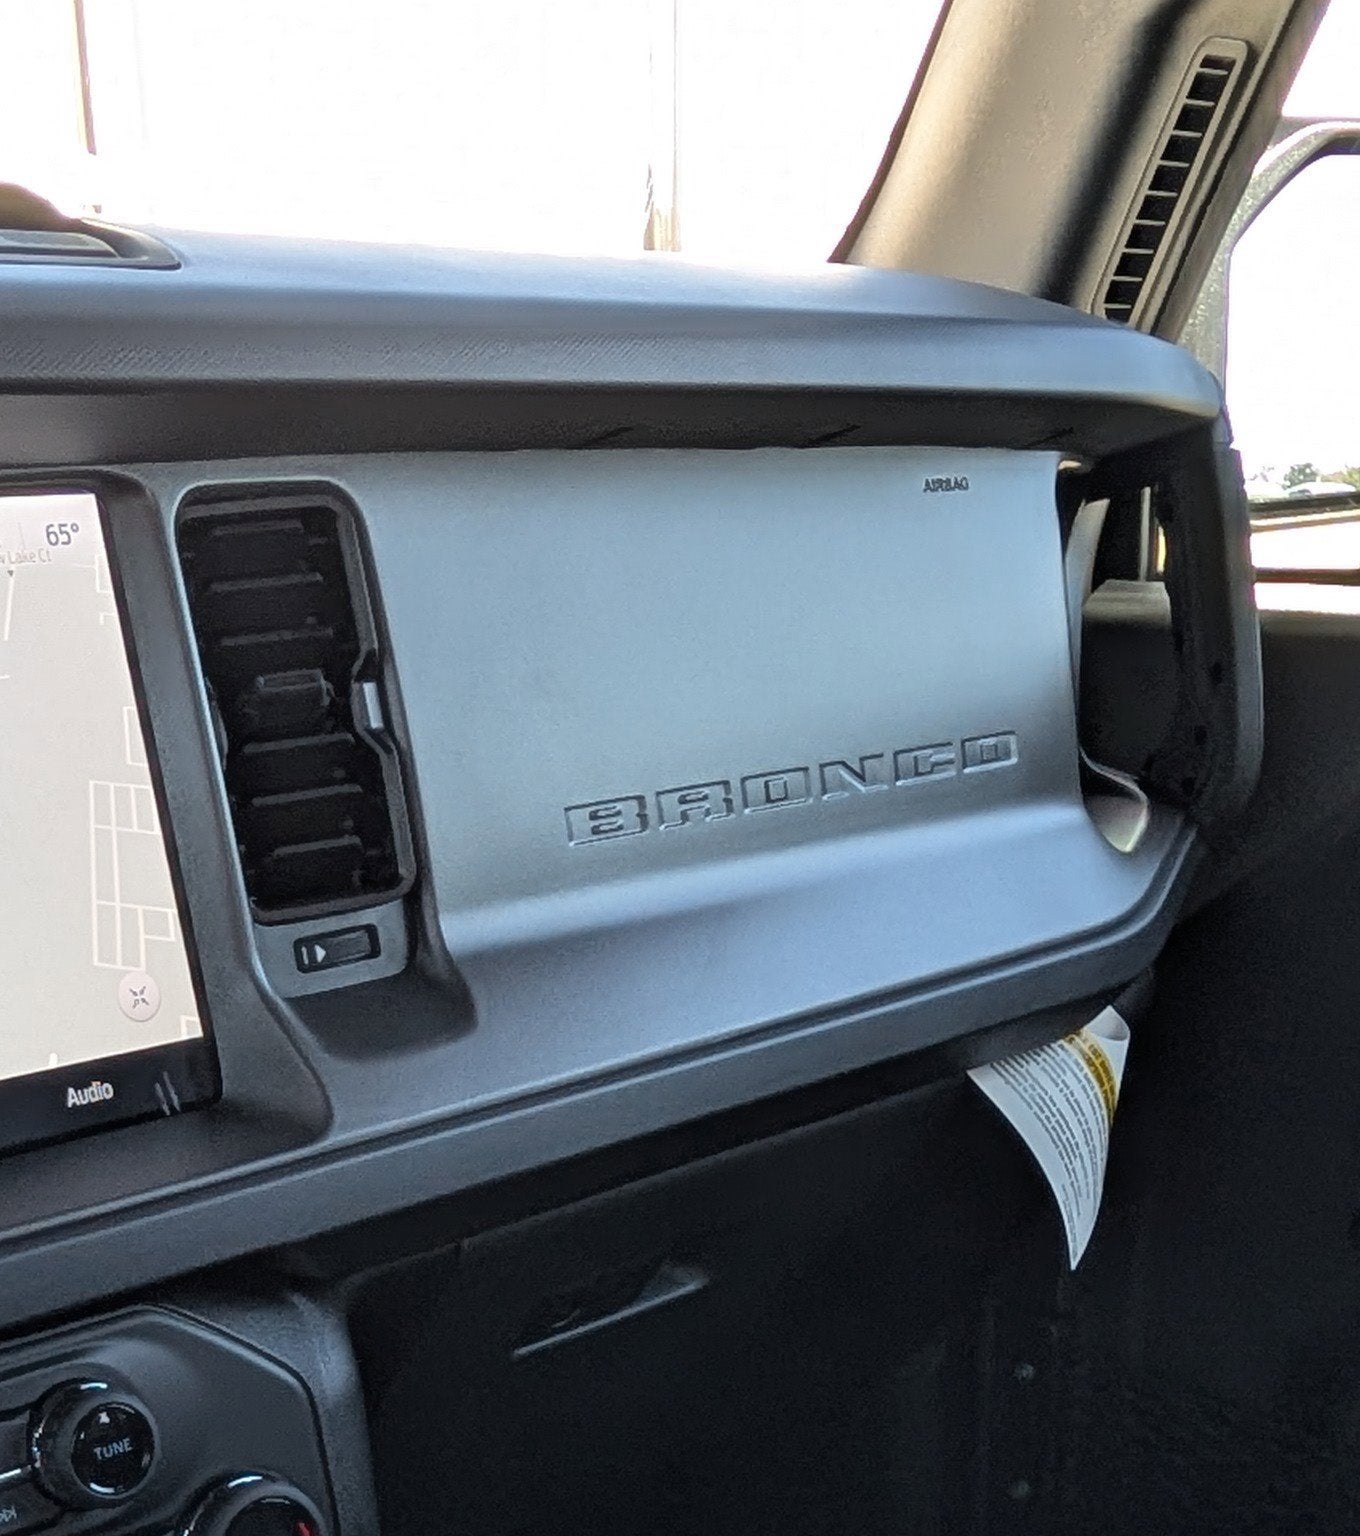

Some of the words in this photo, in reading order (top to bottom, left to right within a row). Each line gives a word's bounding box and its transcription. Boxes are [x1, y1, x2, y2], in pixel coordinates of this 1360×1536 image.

[923, 476, 969, 493] AIRBAG
[44, 522, 80, 547] 65°
[7, 551, 36, 565] Lake
[564, 730, 1019, 848] BRONCO
[66, 1080, 114, 1107] Audio
[94, 1437, 133, 1461] TUNE
